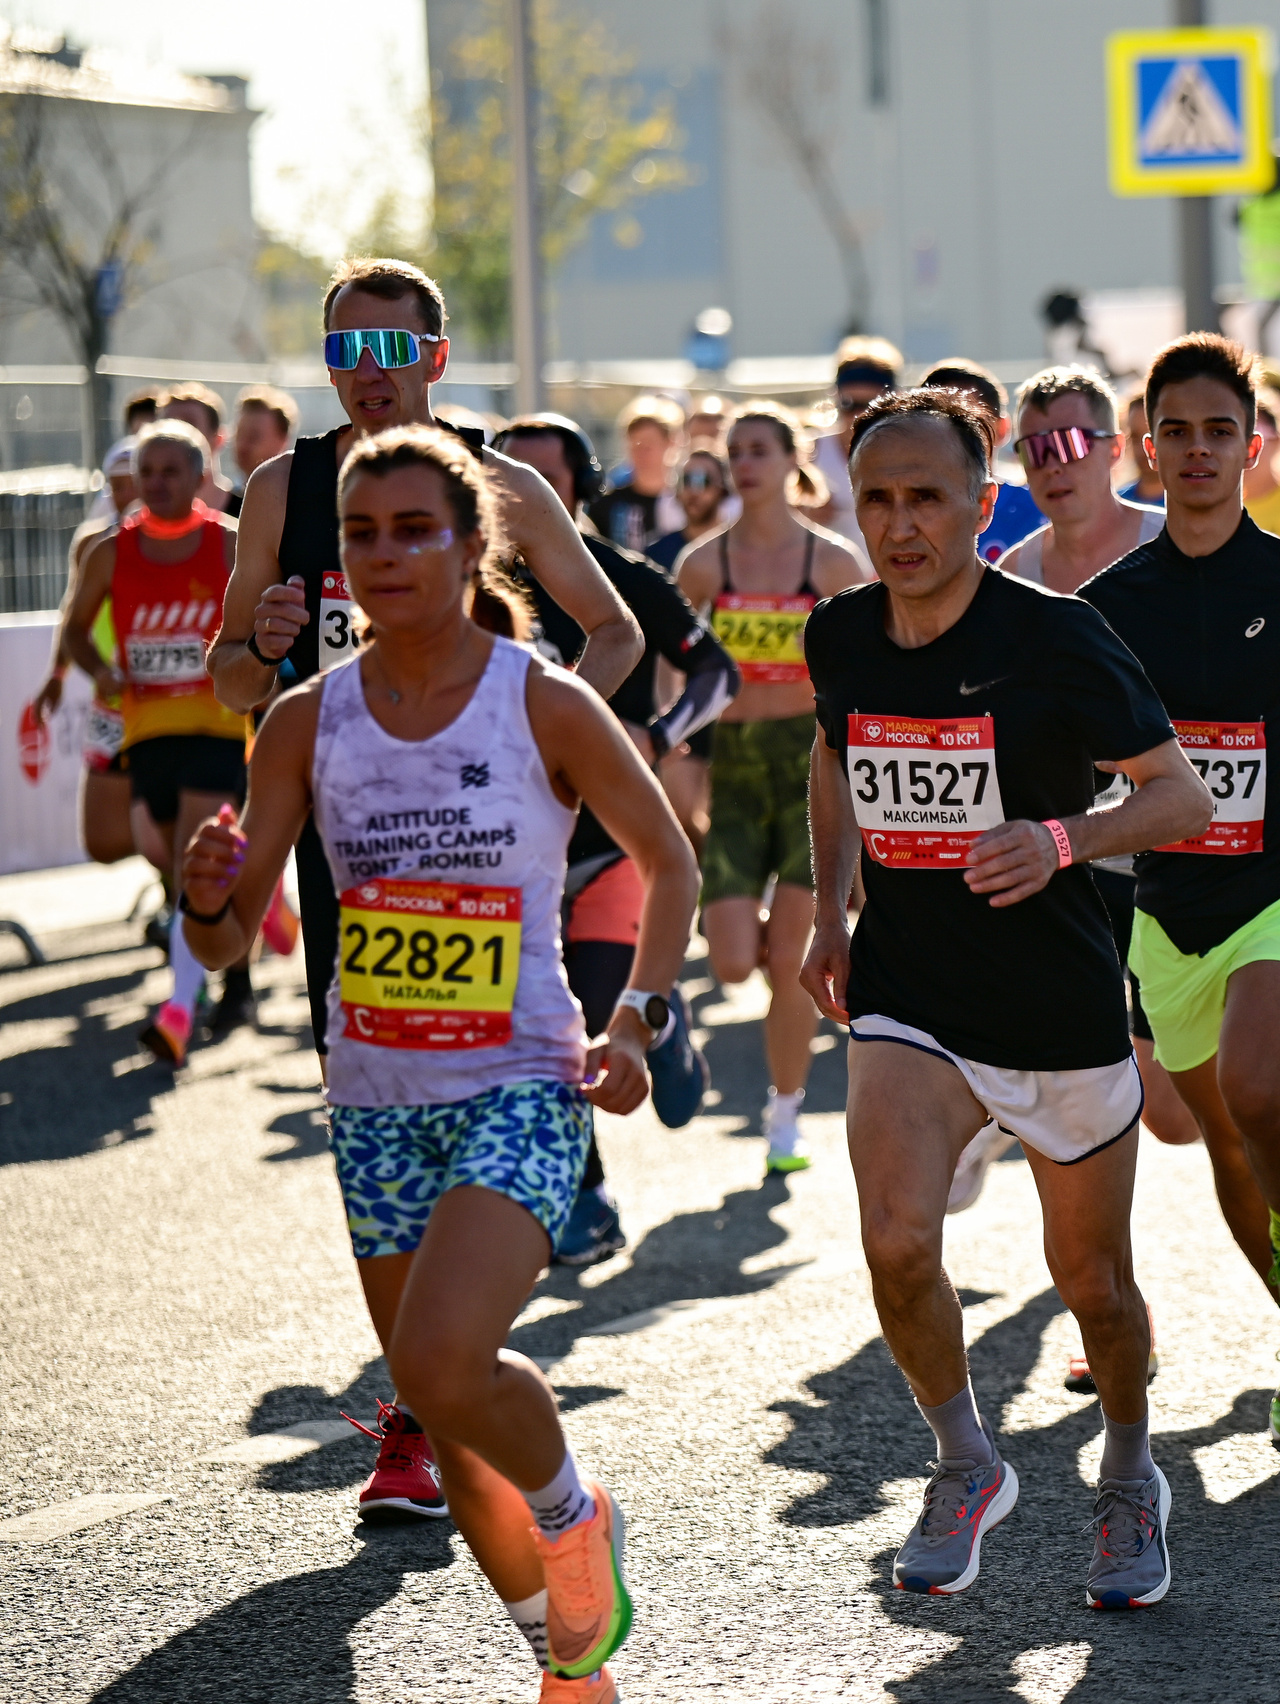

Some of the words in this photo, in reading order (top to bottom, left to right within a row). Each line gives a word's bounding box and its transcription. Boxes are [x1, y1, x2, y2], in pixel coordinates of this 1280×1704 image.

[885, 722, 936, 735] МАРАФОН
[1175, 725, 1219, 735] АРАФОН
[886, 732, 930, 745] МОСКВА
[939, 734, 954, 746] 10
[1176, 735, 1210, 745] ОСКВА
[1221, 735, 1234, 746] 10
[853, 758, 990, 806] 31527
[366, 808, 471, 833] ALTITUDE
[883, 809, 967, 824] МАКСИМБАЙ
[335, 833, 431, 858] TRAINING
[437, 828, 517, 849] CAMPS
[1052, 825, 1070, 857] 31527
[347, 857, 400, 877] FONT
[419, 851, 502, 869] ROMEU
[385, 896, 444, 912] МОСКВА
[459, 900, 477, 914] 10
[344, 922, 504, 985] 22821
[382, 985, 457, 1001] НАТАЛЬЯ
